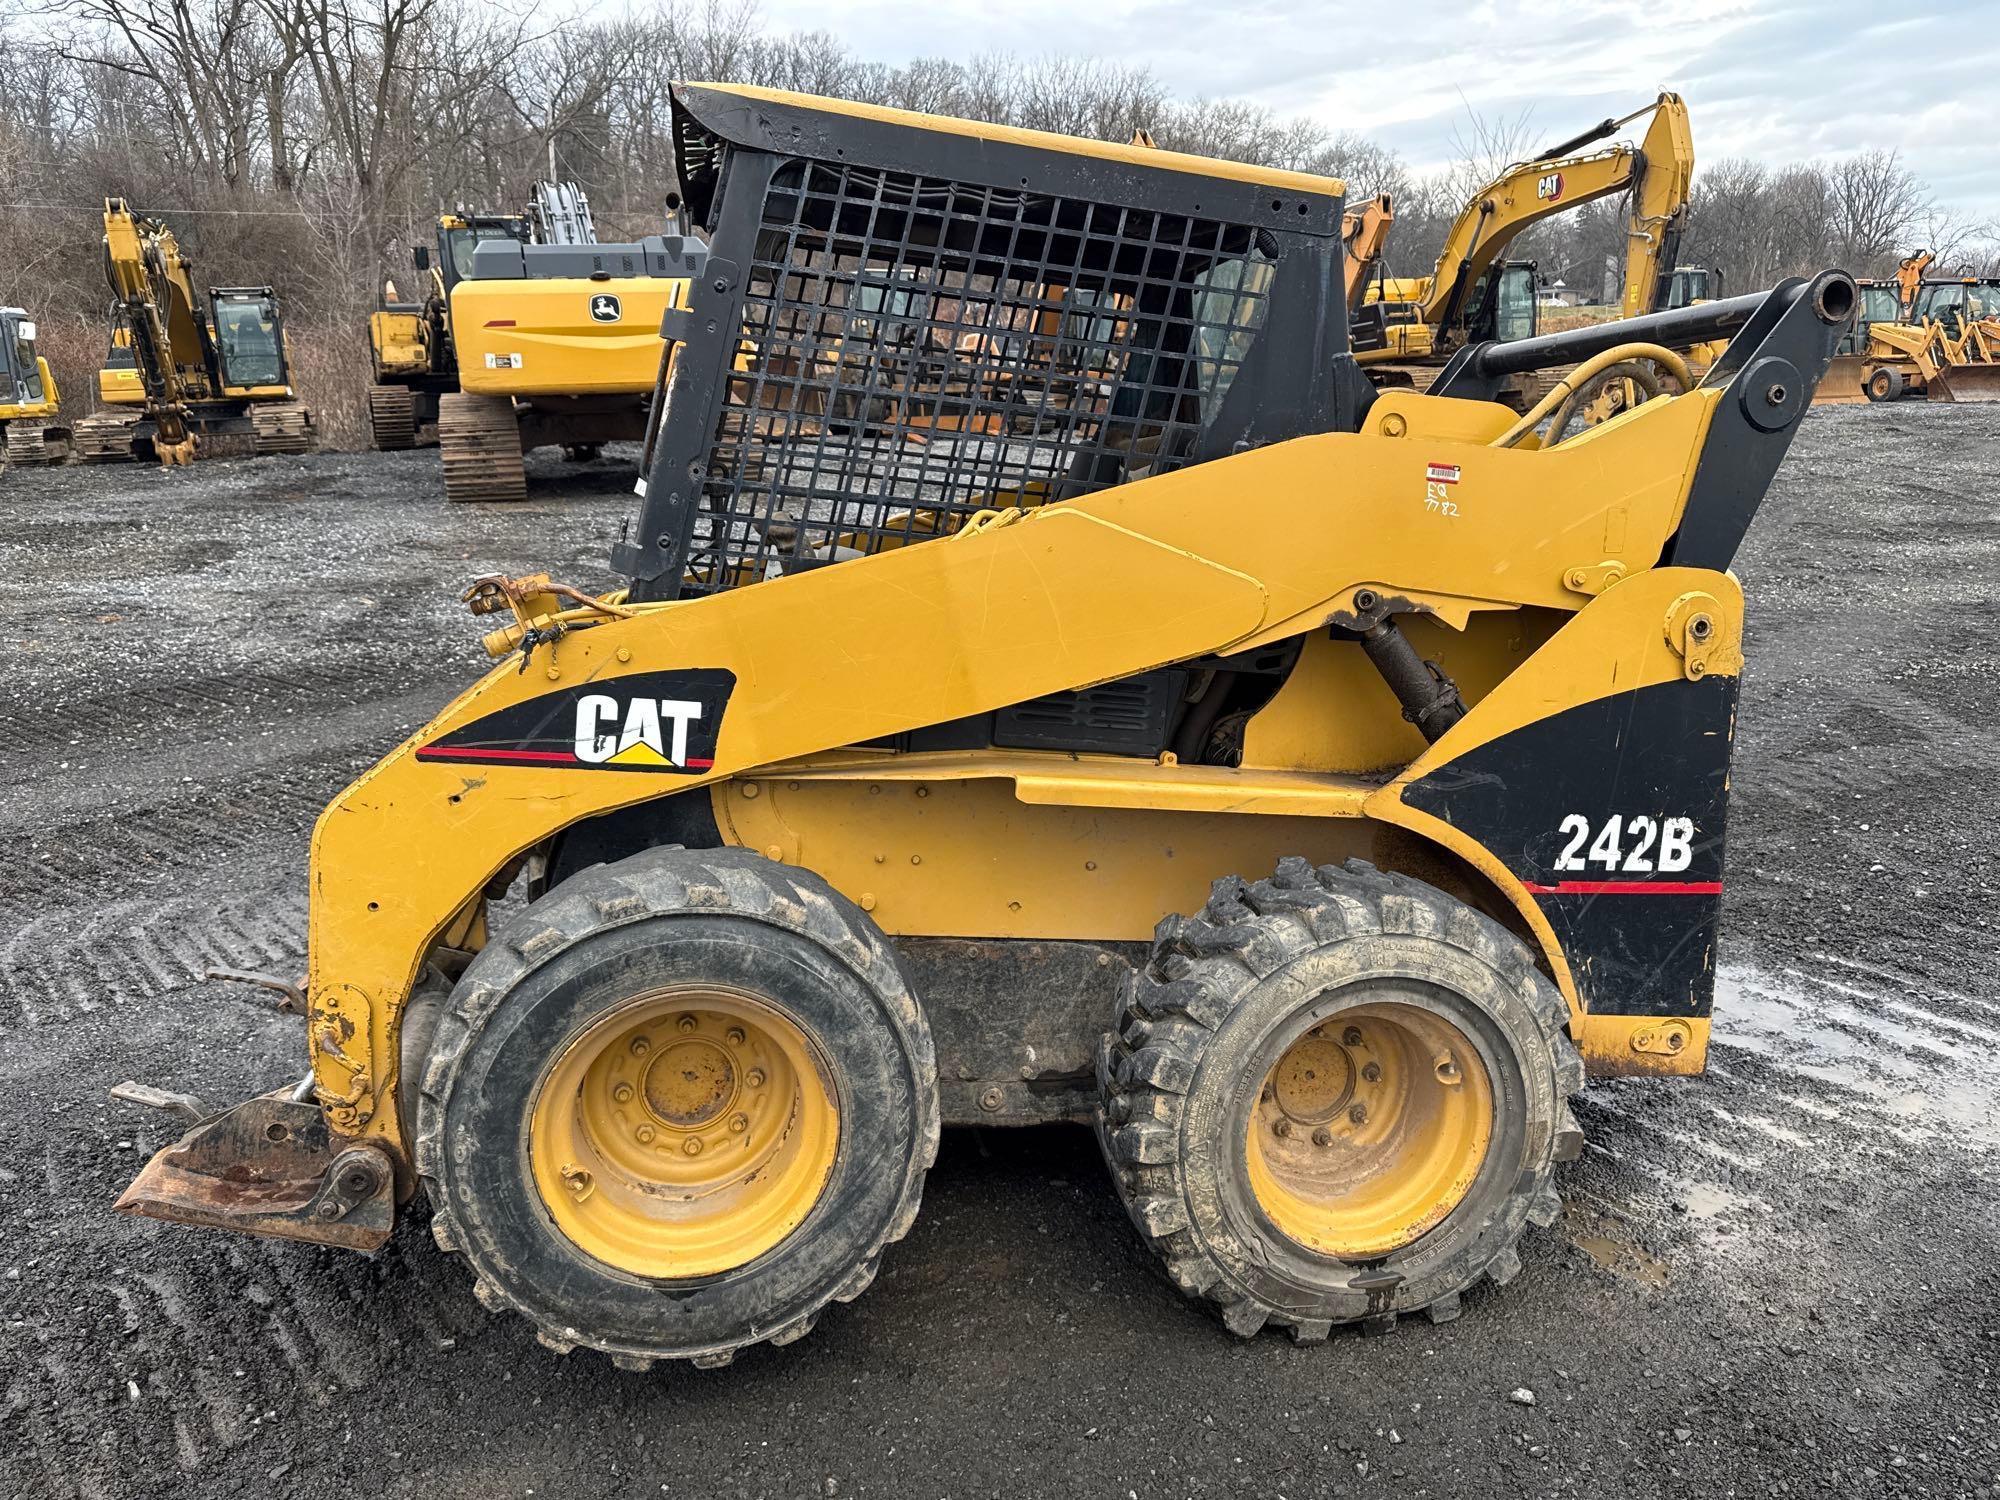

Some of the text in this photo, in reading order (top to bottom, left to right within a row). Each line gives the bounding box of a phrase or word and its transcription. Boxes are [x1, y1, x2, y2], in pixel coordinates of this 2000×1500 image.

[1538, 174, 1559, 199] CAT
[1427, 481, 1448, 499] EQ
[1424, 497, 1460, 517] 7782
[574, 694, 702, 767] CAT
[1553, 813, 1694, 872] 242B
